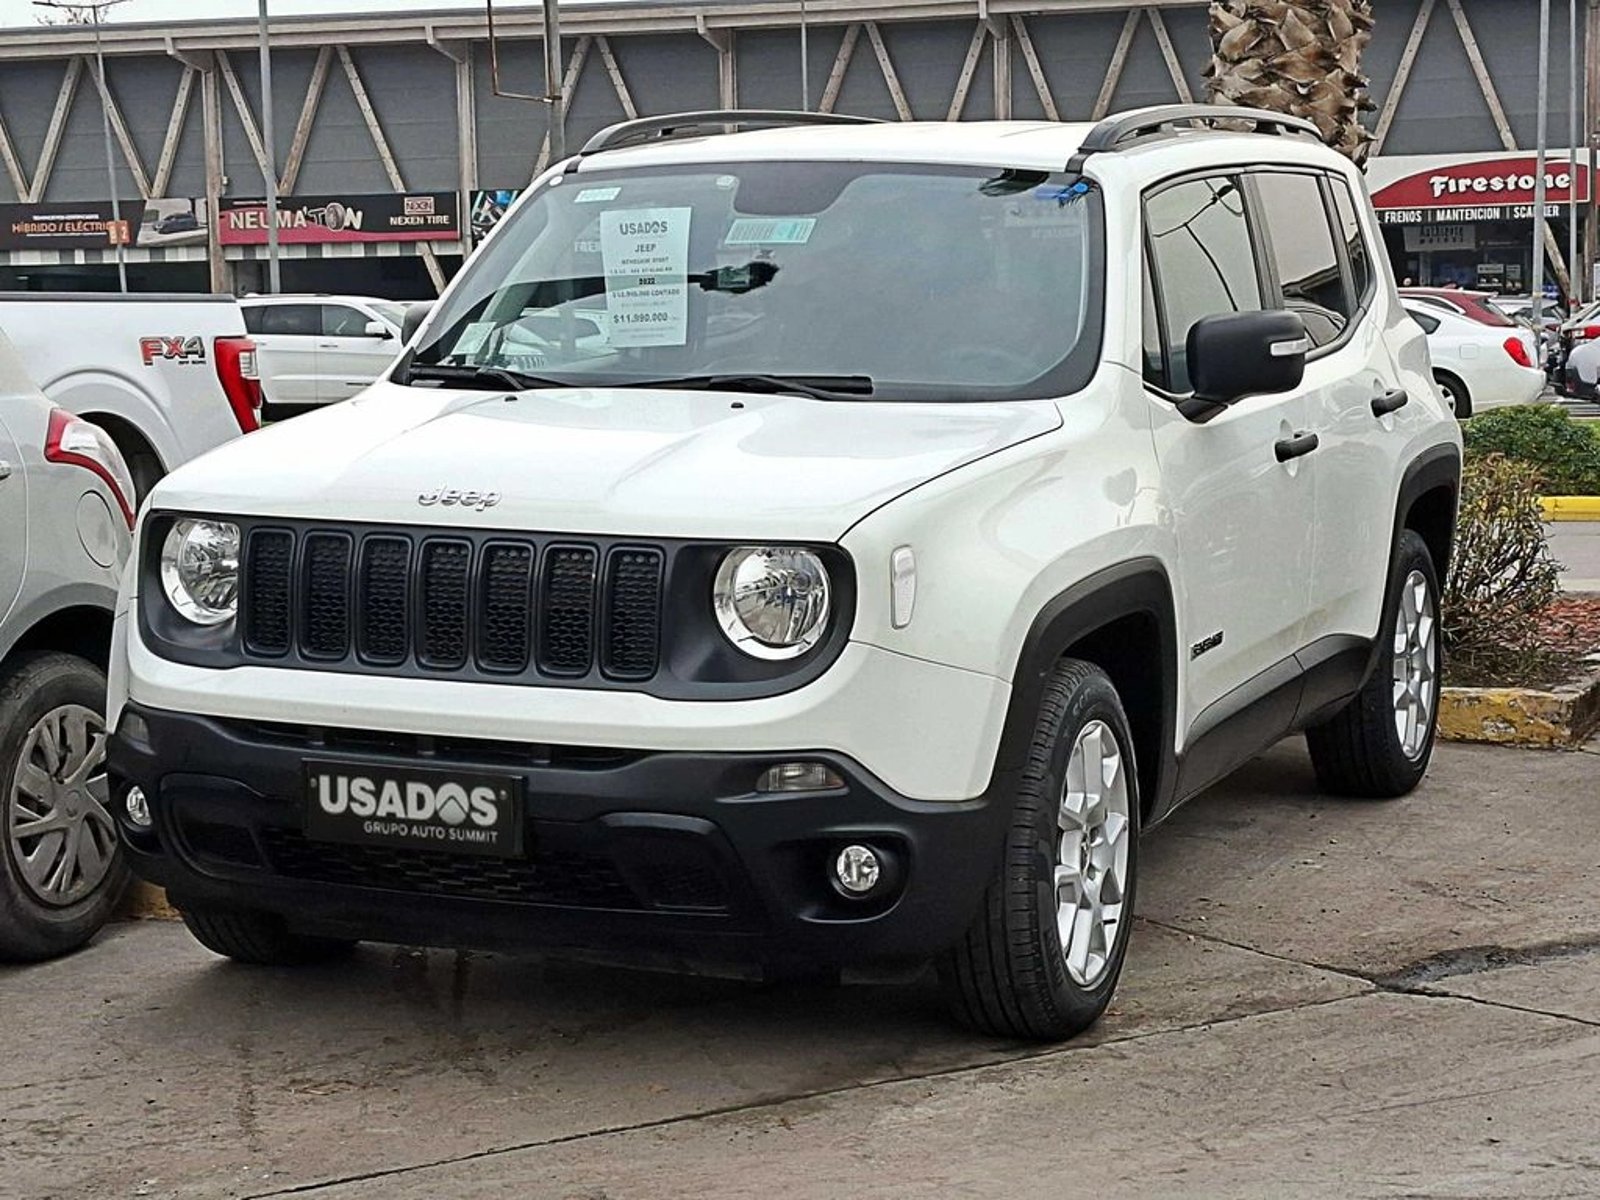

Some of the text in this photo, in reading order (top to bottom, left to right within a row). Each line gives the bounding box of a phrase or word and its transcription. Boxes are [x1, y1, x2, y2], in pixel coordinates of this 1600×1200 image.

[1430, 173, 1570, 198] Firestone
[390, 215, 450, 226] NEXEN TIRE
[1385, 205, 1560, 223] FRENOS MANTENCION SCAER
[620, 221, 668, 235] USADOS
[634, 243, 656, 252] JEEP
[139, 336, 206, 366] FX4
[418, 484, 502, 512] Jeep
[319, 775, 498, 826] USADOS
[364, 821, 498, 843] GRUPO AUTO SUMMIT
